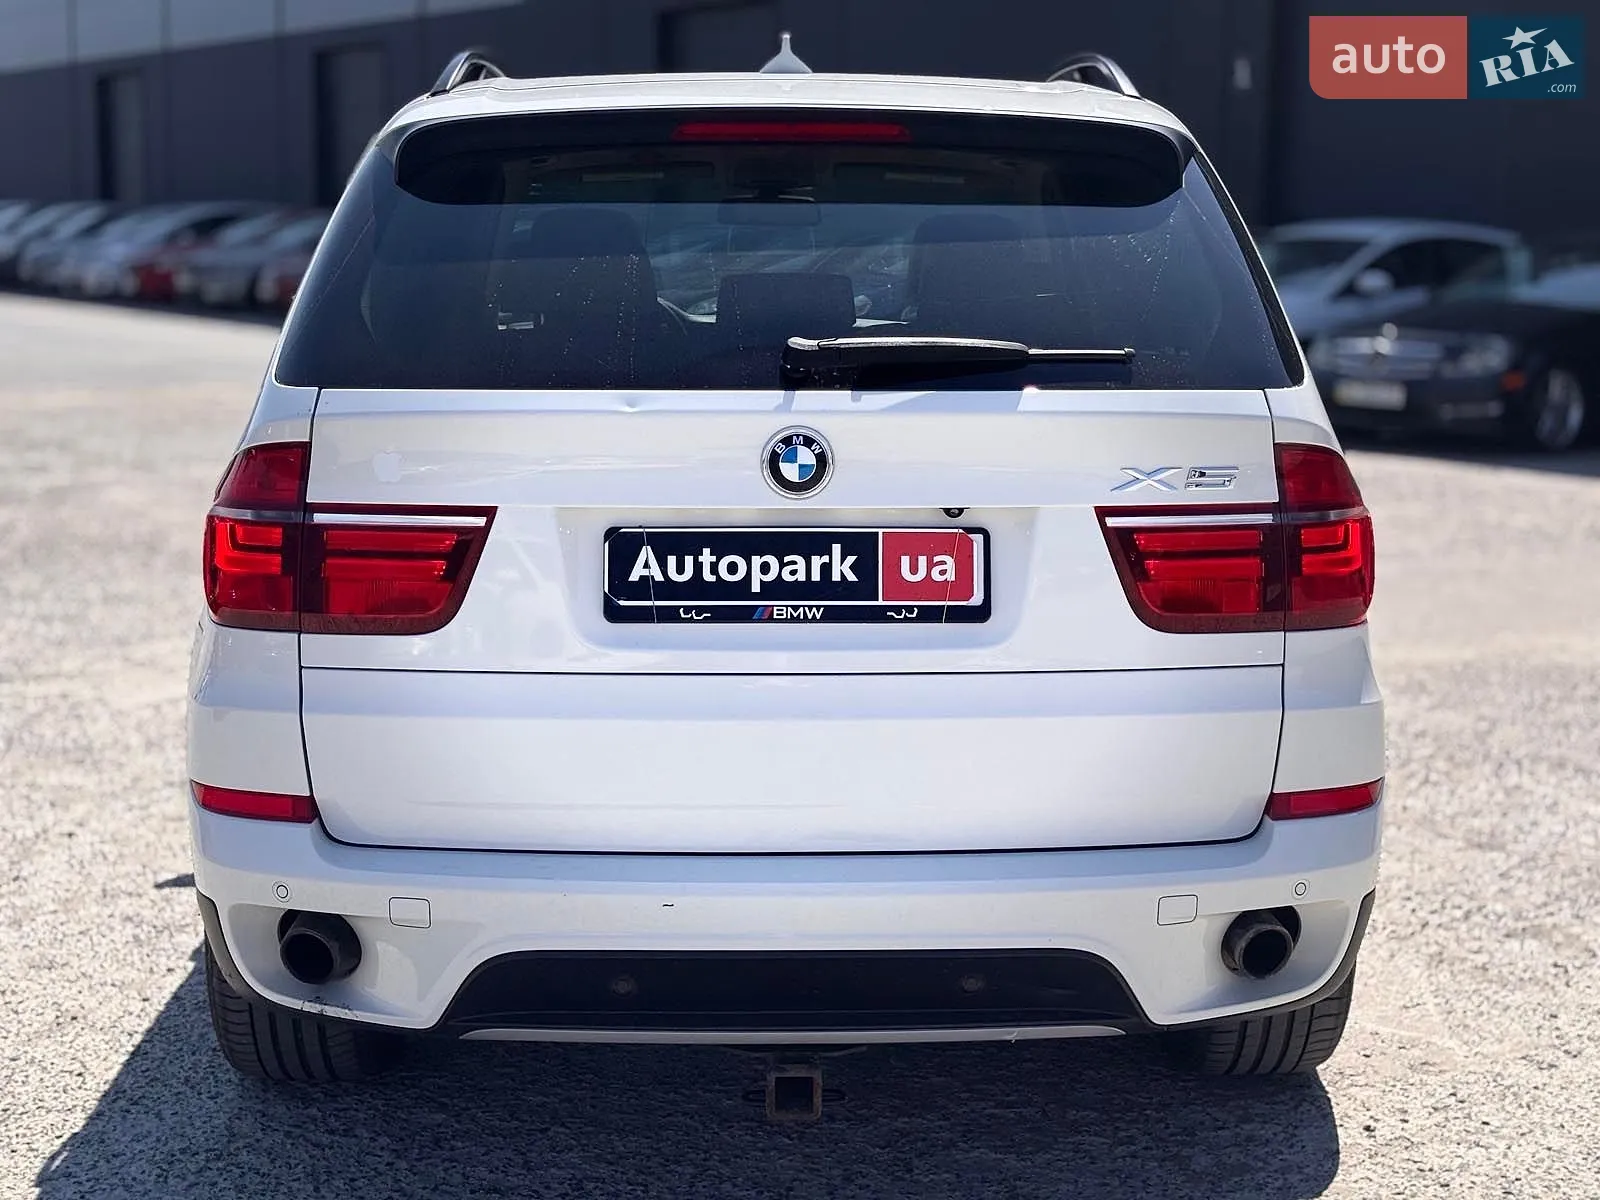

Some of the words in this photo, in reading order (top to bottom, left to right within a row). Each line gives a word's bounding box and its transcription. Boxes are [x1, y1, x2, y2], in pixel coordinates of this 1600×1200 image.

[774, 435, 823, 455] BMW
[1110, 466, 1239, 492] X5
[628, 543, 859, 592] Autopark
[900, 553, 956, 582] ua
[773, 606, 824, 619] BMW
